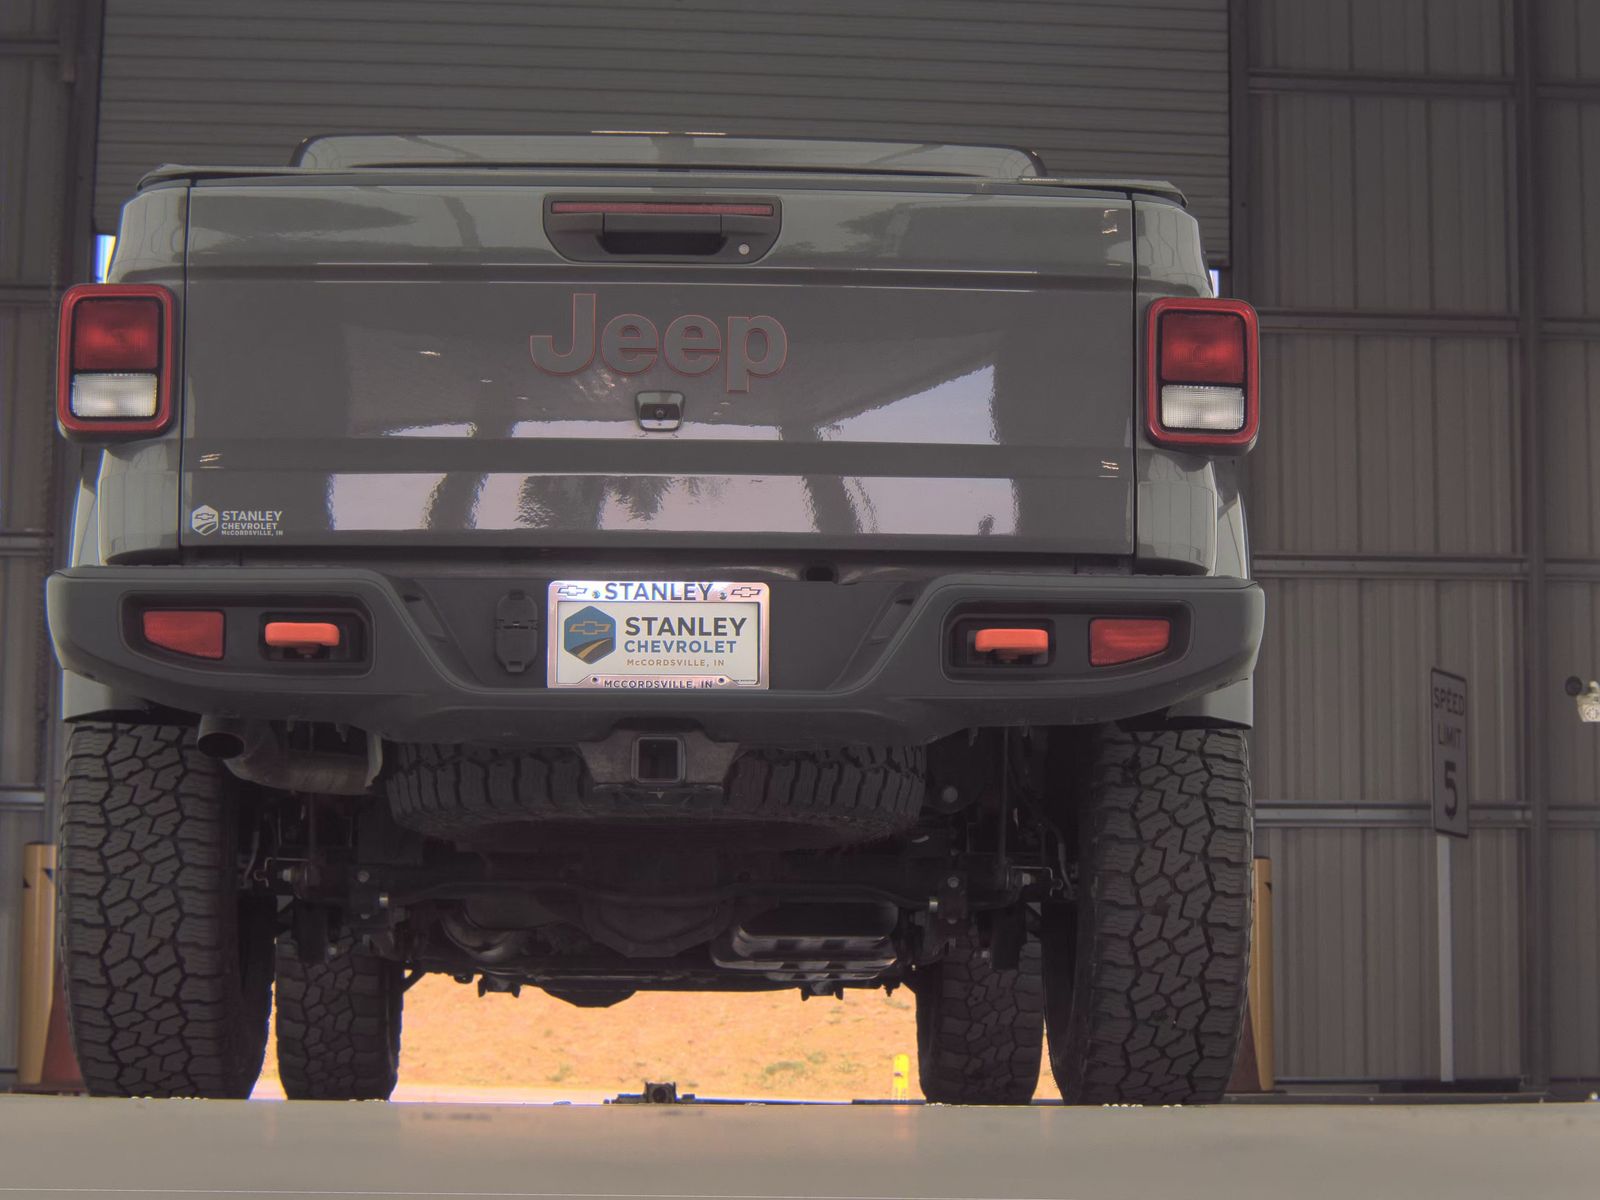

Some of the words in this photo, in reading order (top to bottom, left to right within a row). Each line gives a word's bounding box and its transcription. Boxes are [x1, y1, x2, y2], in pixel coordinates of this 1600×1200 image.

[529, 293, 788, 393] Jeep
[222, 510, 283, 521] STANLEY
[221, 522, 278, 530] CHEVROLET
[604, 582, 714, 601] STANLEY
[625, 616, 747, 637] STANLEY
[624, 640, 737, 654] CHEVROLET
[626, 659, 709, 667] McCORDSVILLE,
[714, 659, 725, 667] IN
[701, 680, 713, 688] IN
[1433, 687, 1465, 716] SPEED
[1438, 723, 1462, 748] LIMIT
[1444, 760, 1458, 820] 5
